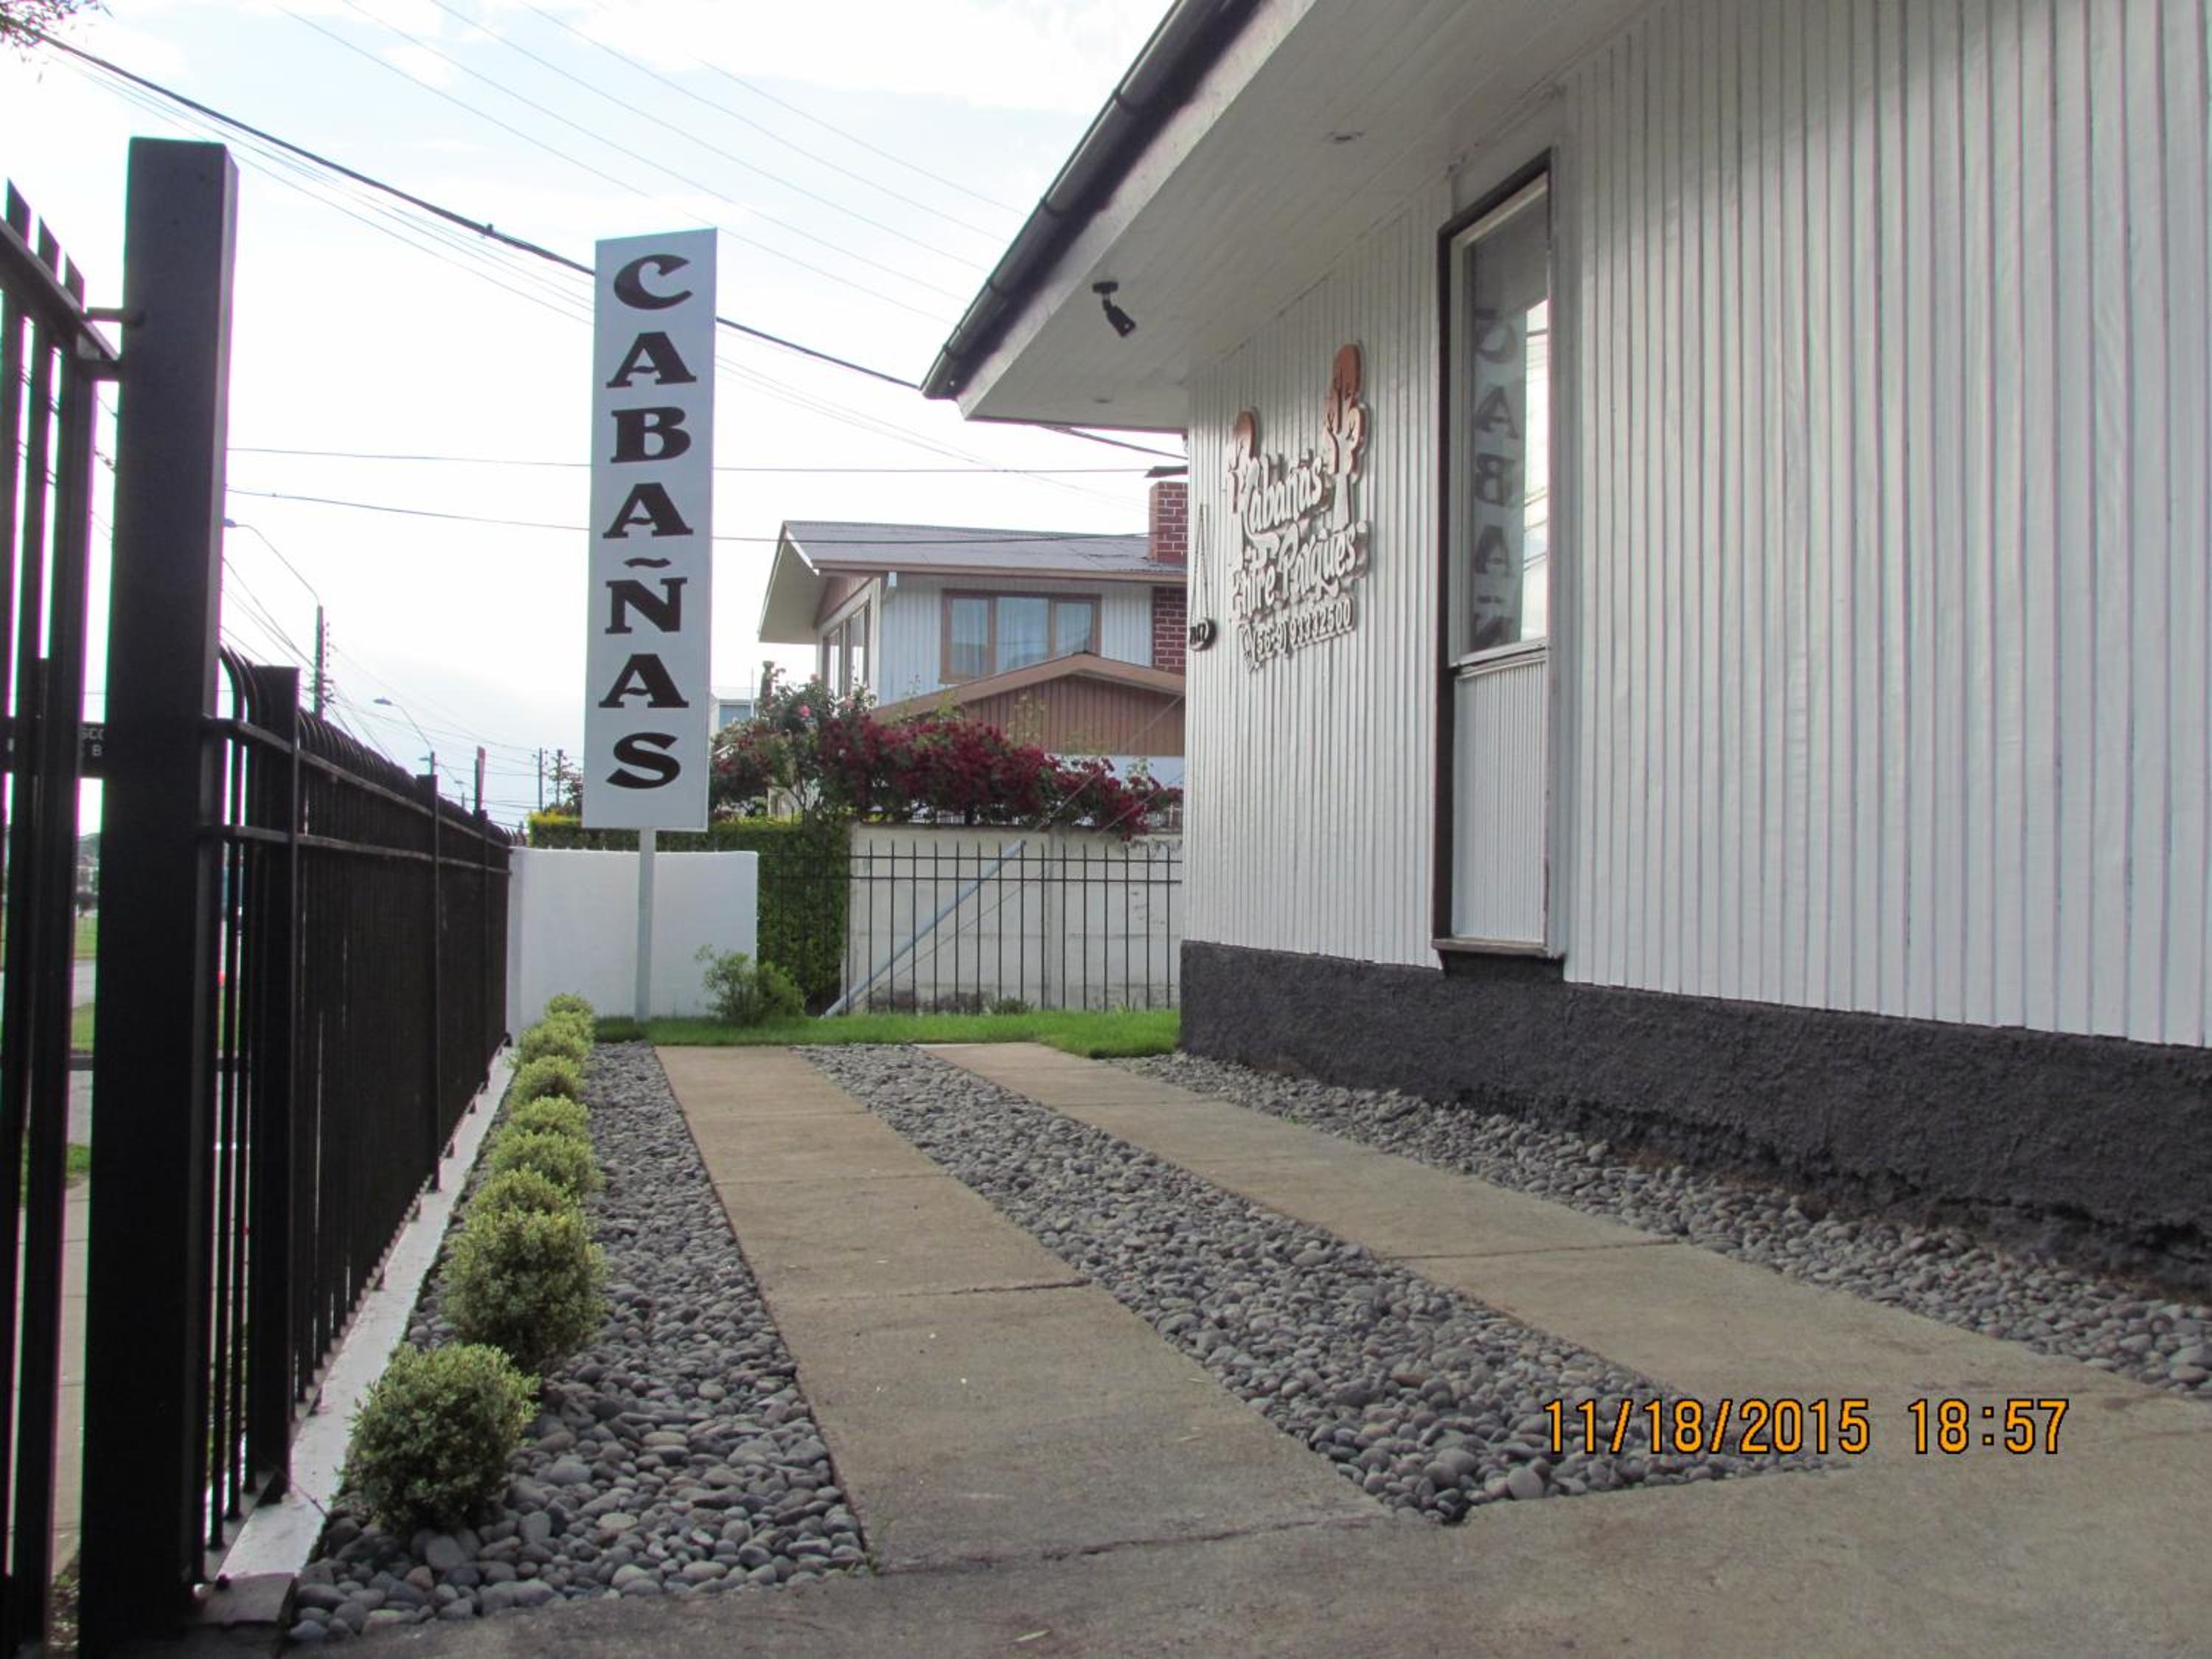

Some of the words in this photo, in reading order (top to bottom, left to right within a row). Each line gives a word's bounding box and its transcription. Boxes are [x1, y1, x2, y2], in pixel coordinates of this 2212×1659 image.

[599, 254, 697, 789] CABAÑAS
[1230, 549, 1276, 624] Entre
[1277, 522, 1357, 601] Parques
